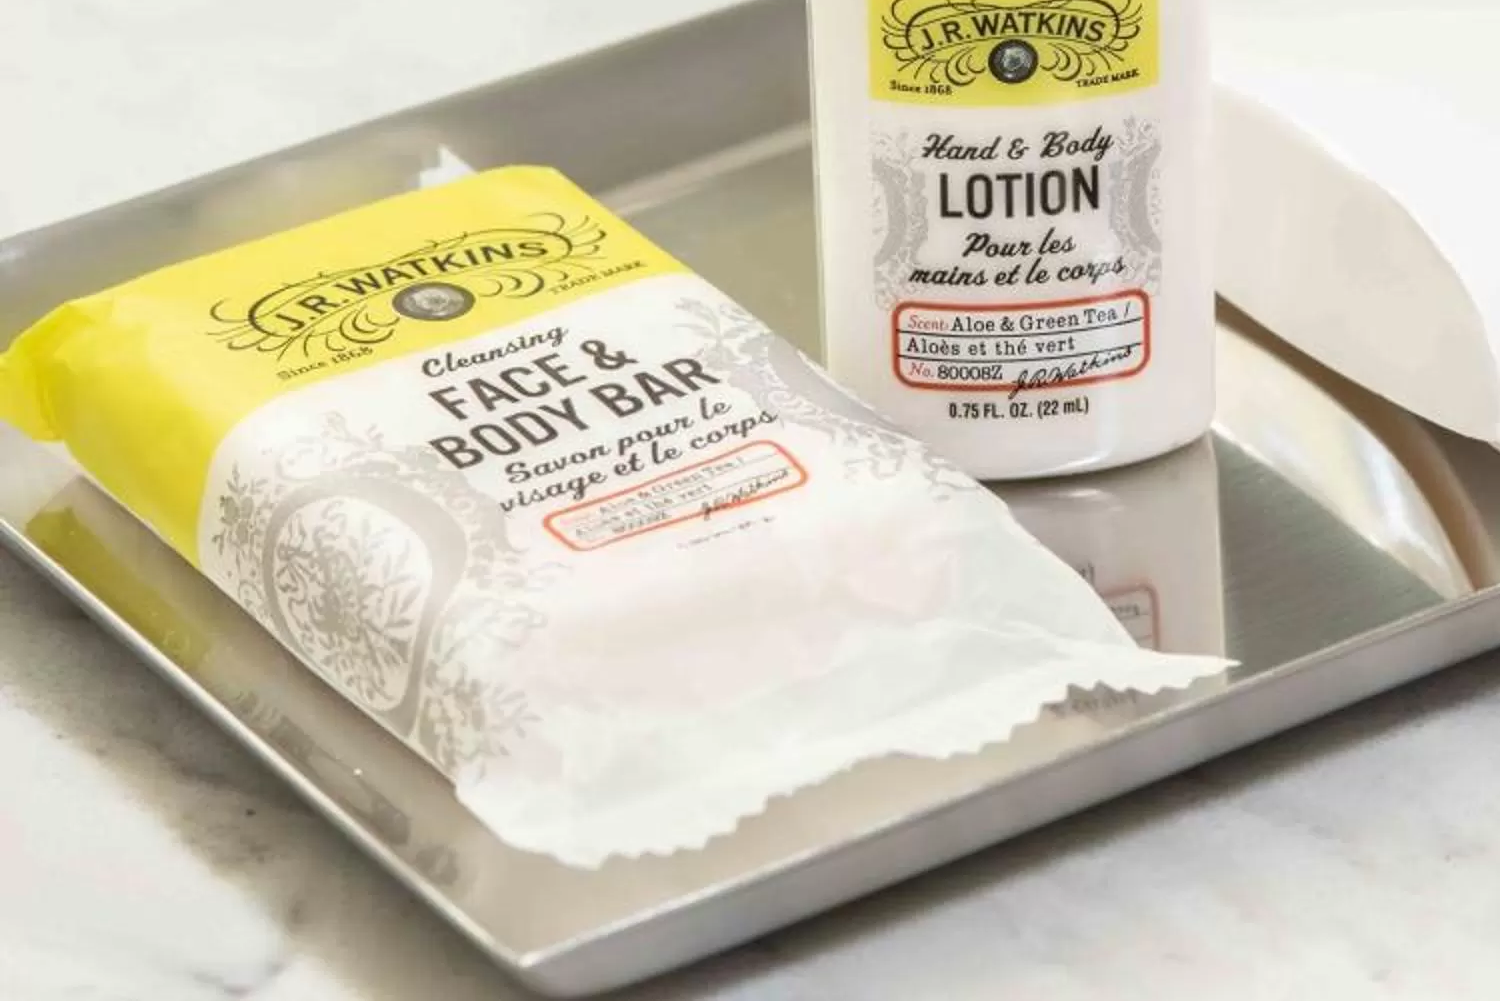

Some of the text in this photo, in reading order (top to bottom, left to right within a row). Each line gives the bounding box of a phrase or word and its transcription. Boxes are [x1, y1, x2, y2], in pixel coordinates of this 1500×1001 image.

[890, 79, 953, 95] Since 1868
[1075, 68, 1139, 88] TRADE MARK
[921, 125, 1115, 160] Hand & Body
[939, 165, 1099, 219] LOTION
[962, 227, 1077, 258] Pour les
[549, 260, 648, 296] TRADE MARK
[908, 256, 1127, 286] mains et le corps
[950, 316, 995, 332] Aloe
[1000, 317, 1015, 332] &
[1019, 313, 1079, 331] Green
[1083, 309, 1117, 325] Tea
[277, 345, 374, 380] Since 1868
[421, 324, 569, 378] Cleansing
[907, 337, 1075, 356] Aloès et thé vert
[428, 339, 638, 420] FACE &
[909, 362, 935, 377] No.
[429, 357, 721, 470] BODY BAR
[949, 403, 979, 419] 0.75
[983, 403, 1005, 419] FL.
[1009, 403, 1033, 417] OZ.
[1037, 401, 1059, 419] (22
[504, 396, 732, 485] Savon pour le
[500, 410, 779, 512] visage et le corps
